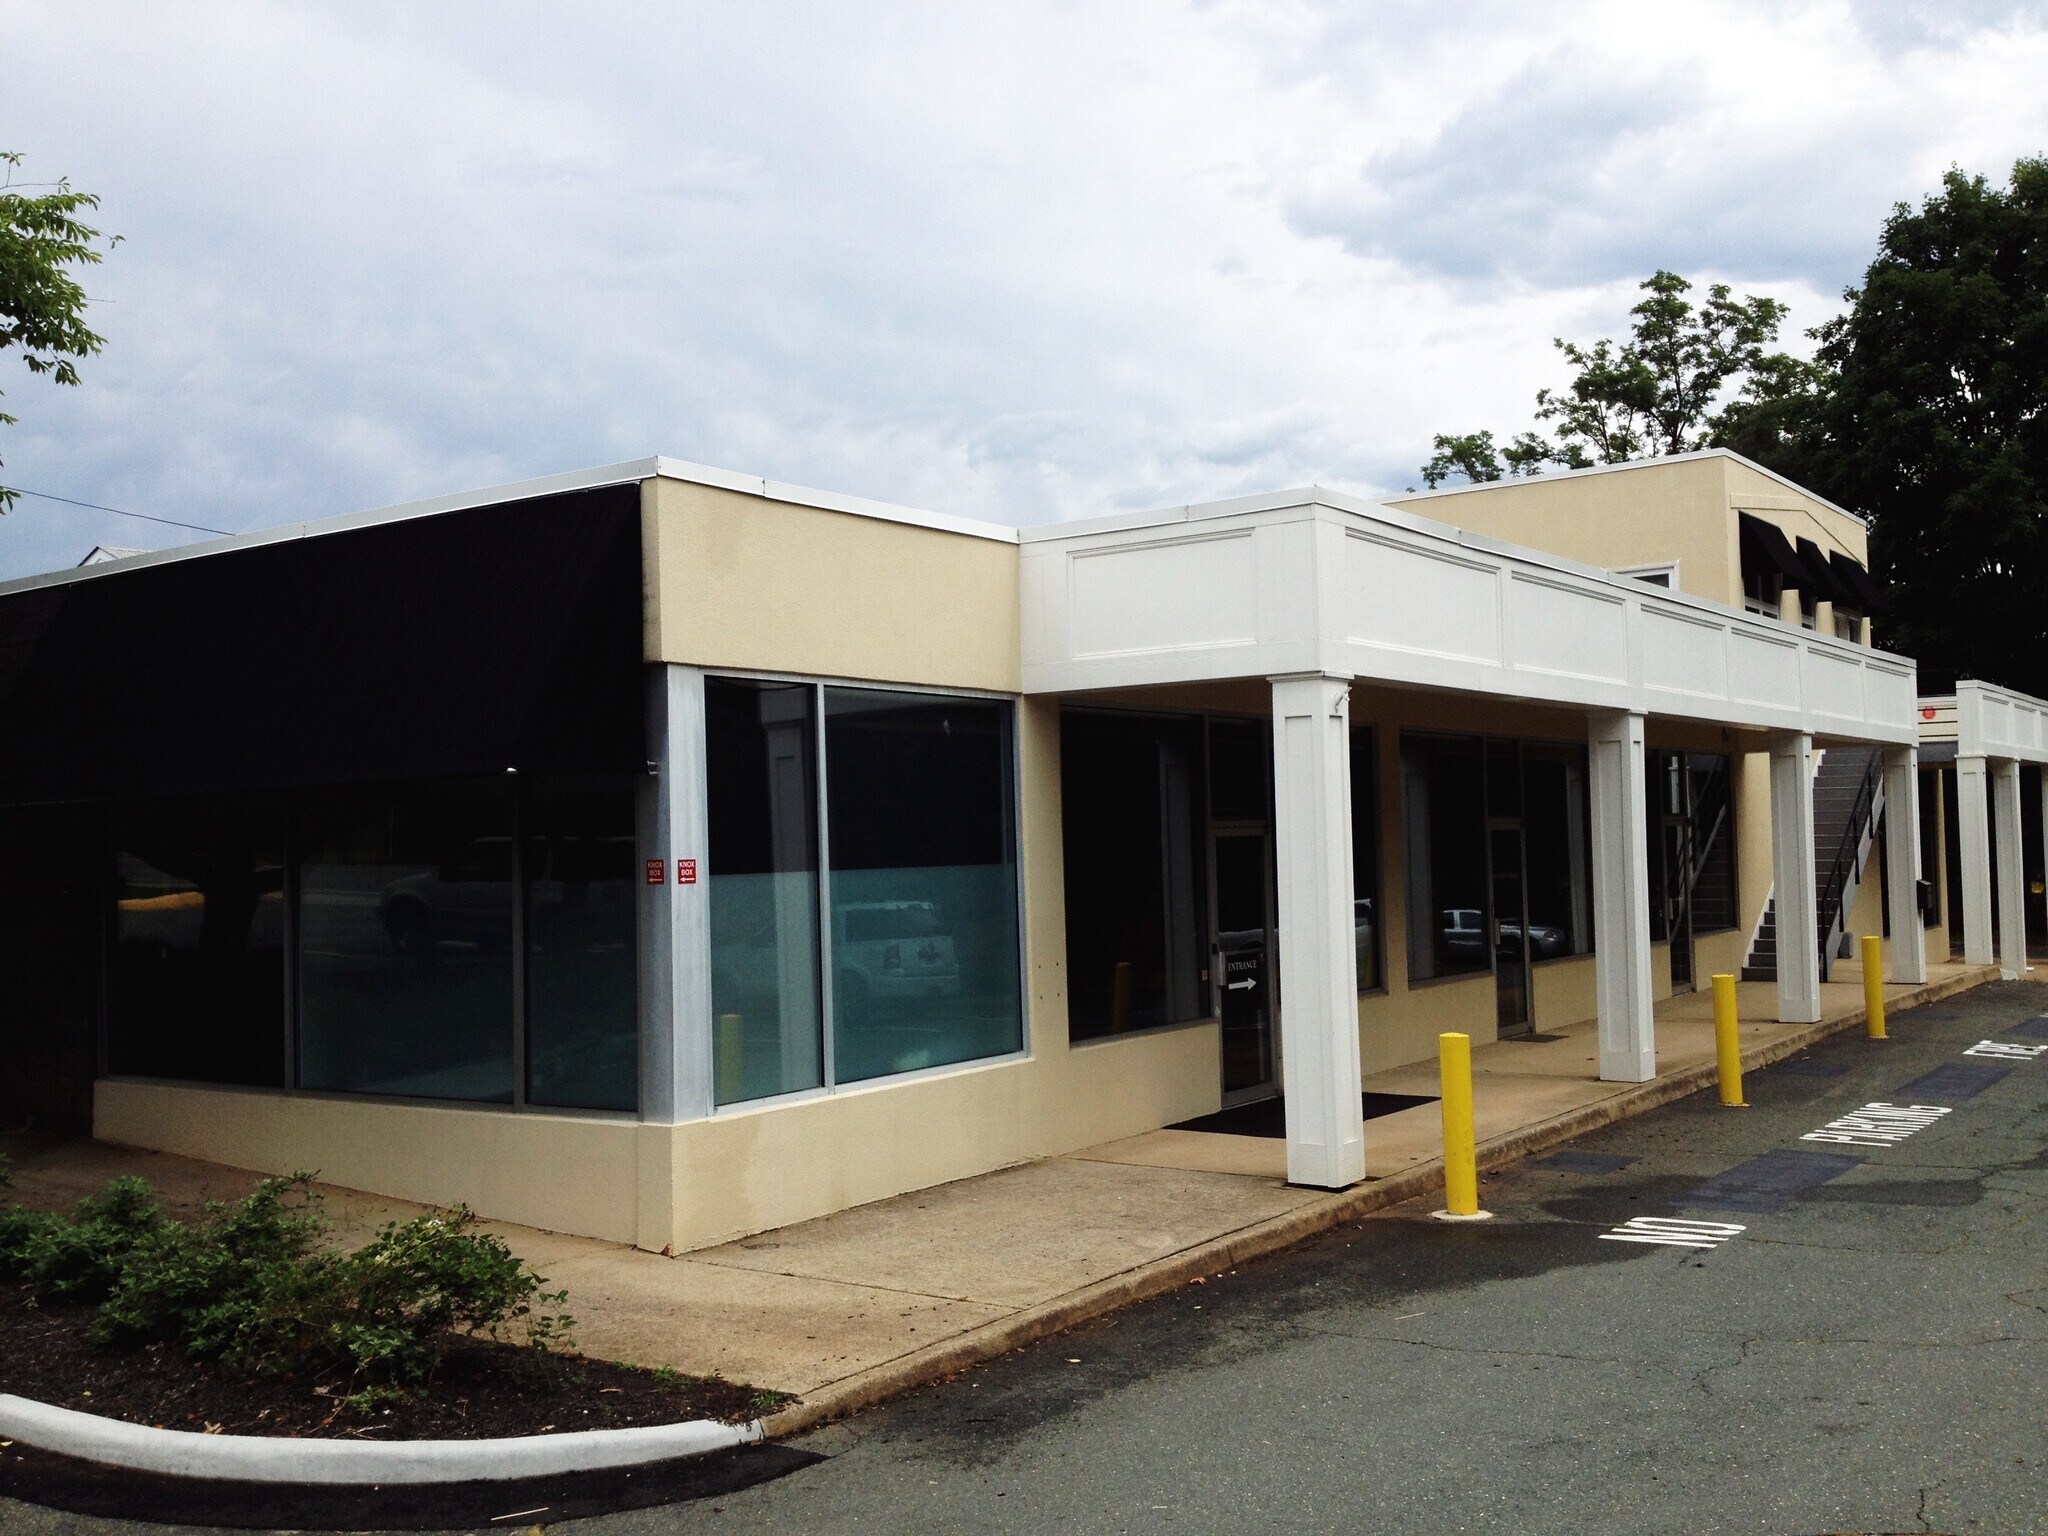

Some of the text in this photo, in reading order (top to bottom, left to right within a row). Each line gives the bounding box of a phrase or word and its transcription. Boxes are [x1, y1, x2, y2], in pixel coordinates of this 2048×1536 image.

[1228, 960, 1257, 972] ENTRANCE
[1597, 1216, 1747, 1248] NO
[1798, 1102, 1953, 1147] PARKING
